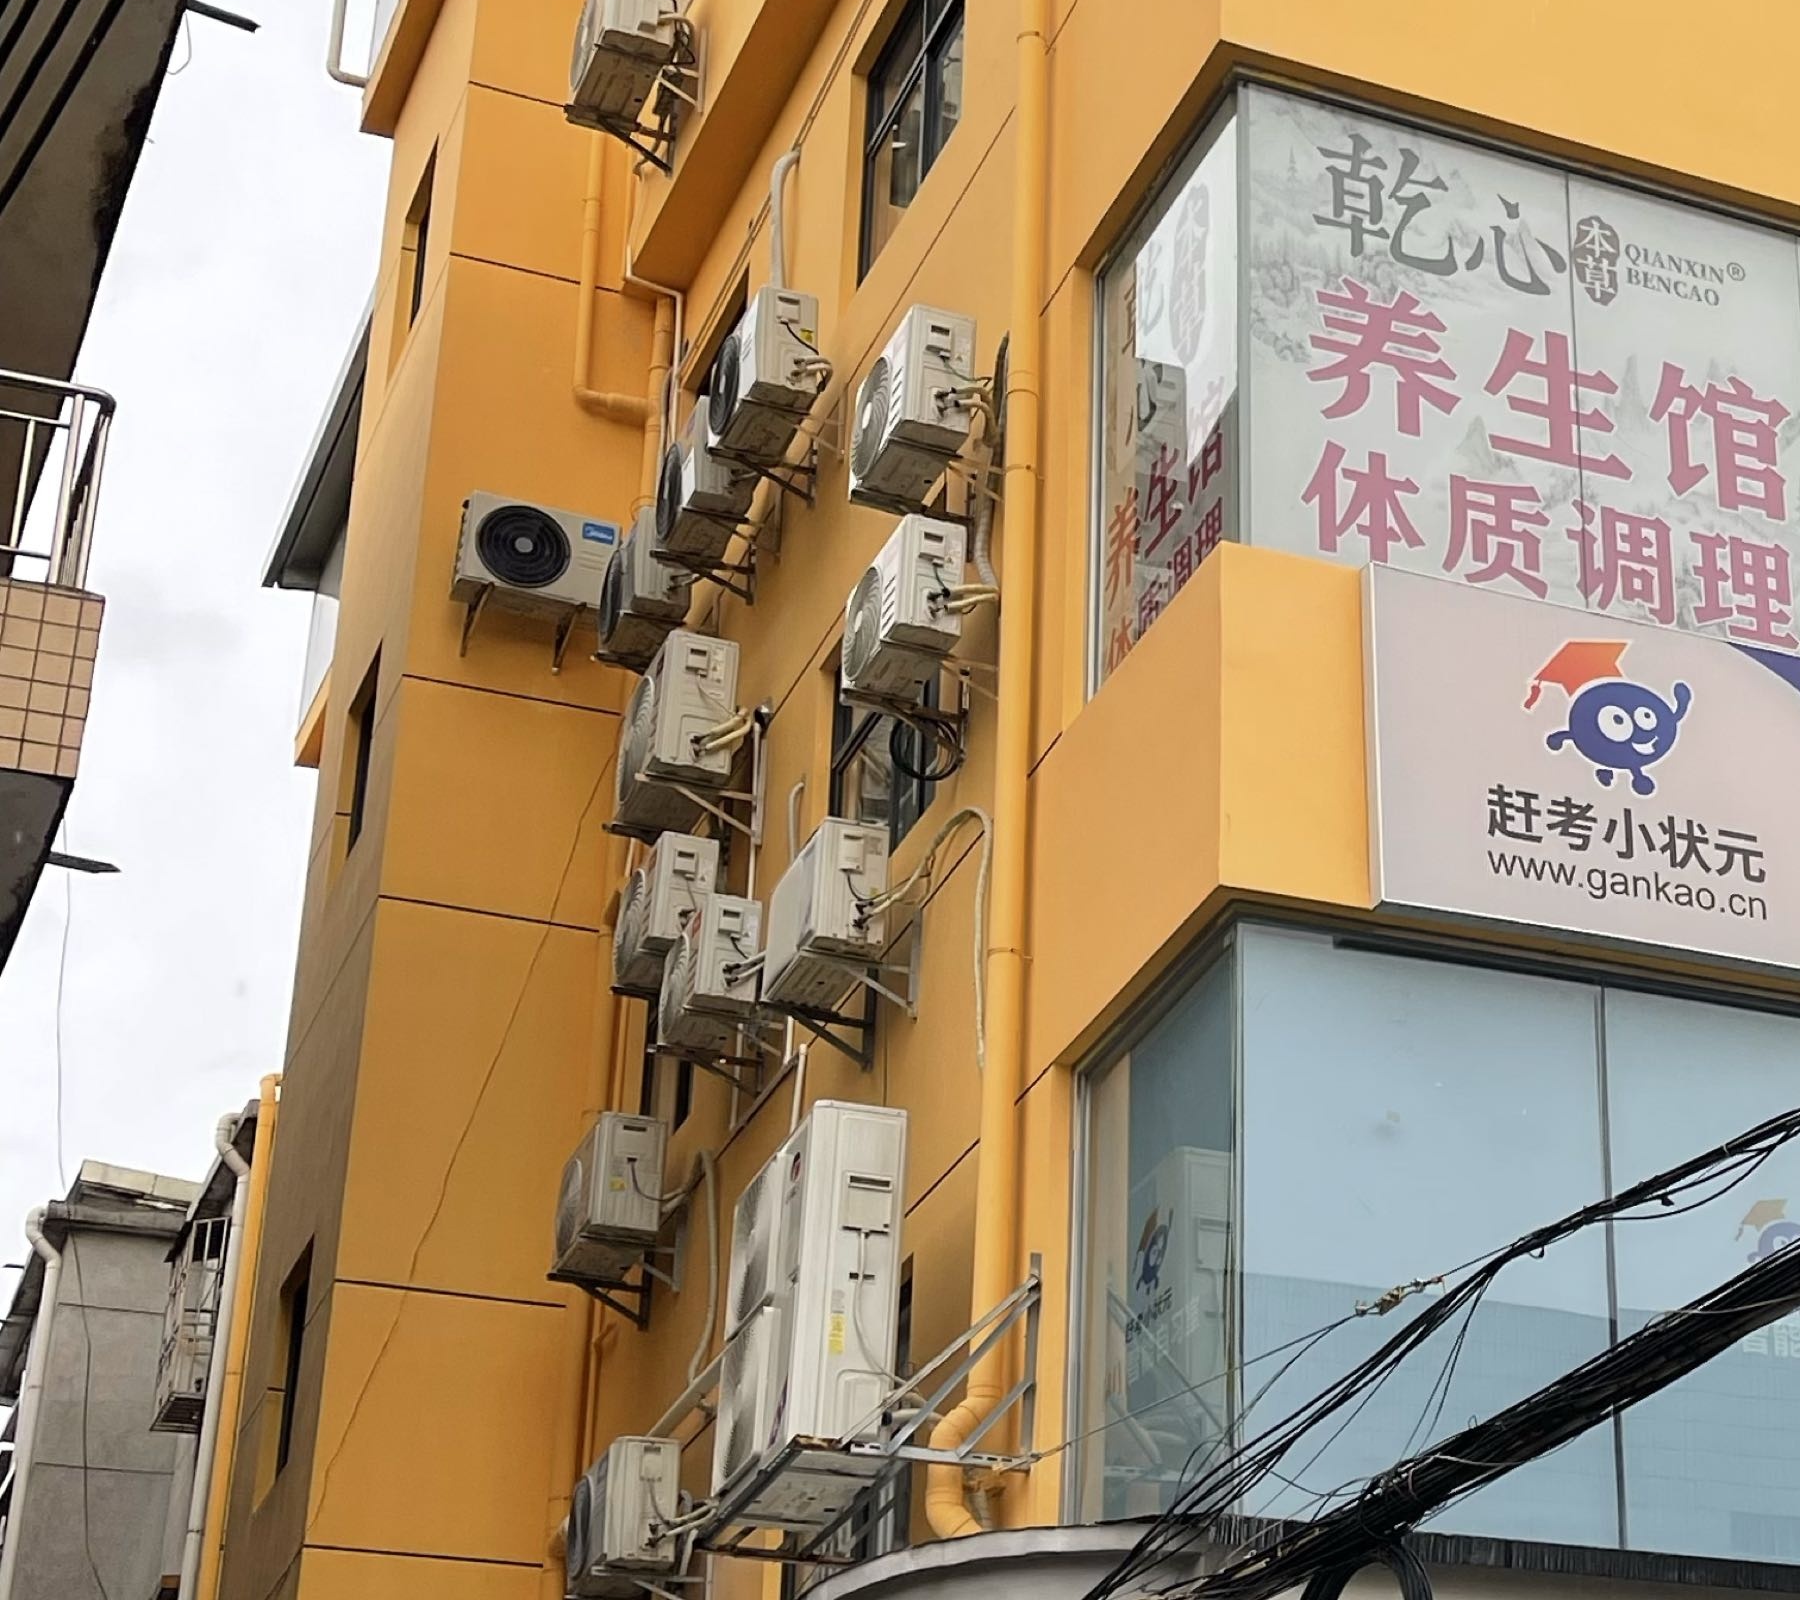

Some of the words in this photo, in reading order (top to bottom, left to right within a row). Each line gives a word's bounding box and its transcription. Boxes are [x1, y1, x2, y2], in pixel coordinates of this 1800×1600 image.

[1312, 131, 1569, 297] 乾心
[1575, 219, 1618, 299] 本草
[1626, 266, 1720, 306] BENCAO
[1306, 276, 1792, 524] 养生馆
[1302, 438, 1800, 651] 体质调理
[1486, 784, 1767, 884] 赶考小状元
[1487, 849, 1769, 921] www.gankao.cn
